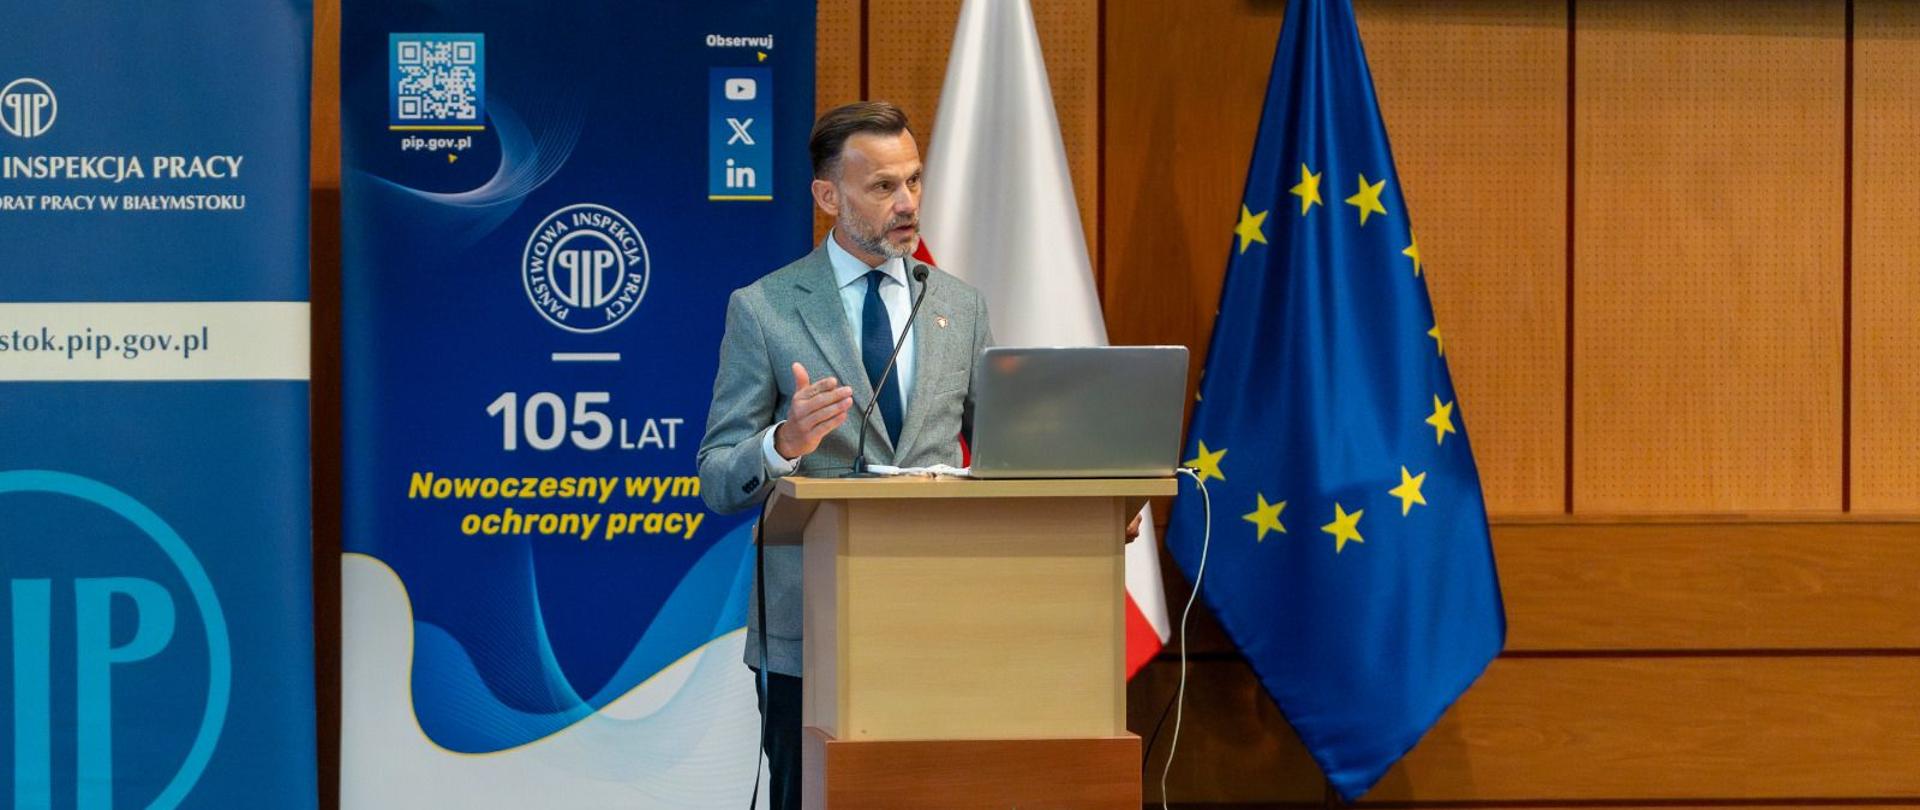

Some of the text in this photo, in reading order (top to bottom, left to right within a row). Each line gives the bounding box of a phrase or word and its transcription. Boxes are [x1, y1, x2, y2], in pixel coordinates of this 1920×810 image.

[706, 34, 773, 49] Obserwuj
[401, 136, 472, 151] pip.gov.pl
[4, 155, 244, 183] INSPEKCJA PRACY
[726, 159, 756, 188] in
[0, 195, 246, 210] RAT PRACY W BIAŁYMSTOKU
[530, 212, 642, 321] PAŃSTWOWA INSPEKCJA PRACY
[486, 392, 684, 451] 105 LAT
[408, 472, 701, 503] Nowoczesny wym
[461, 508, 704, 540] ochrony pracy
